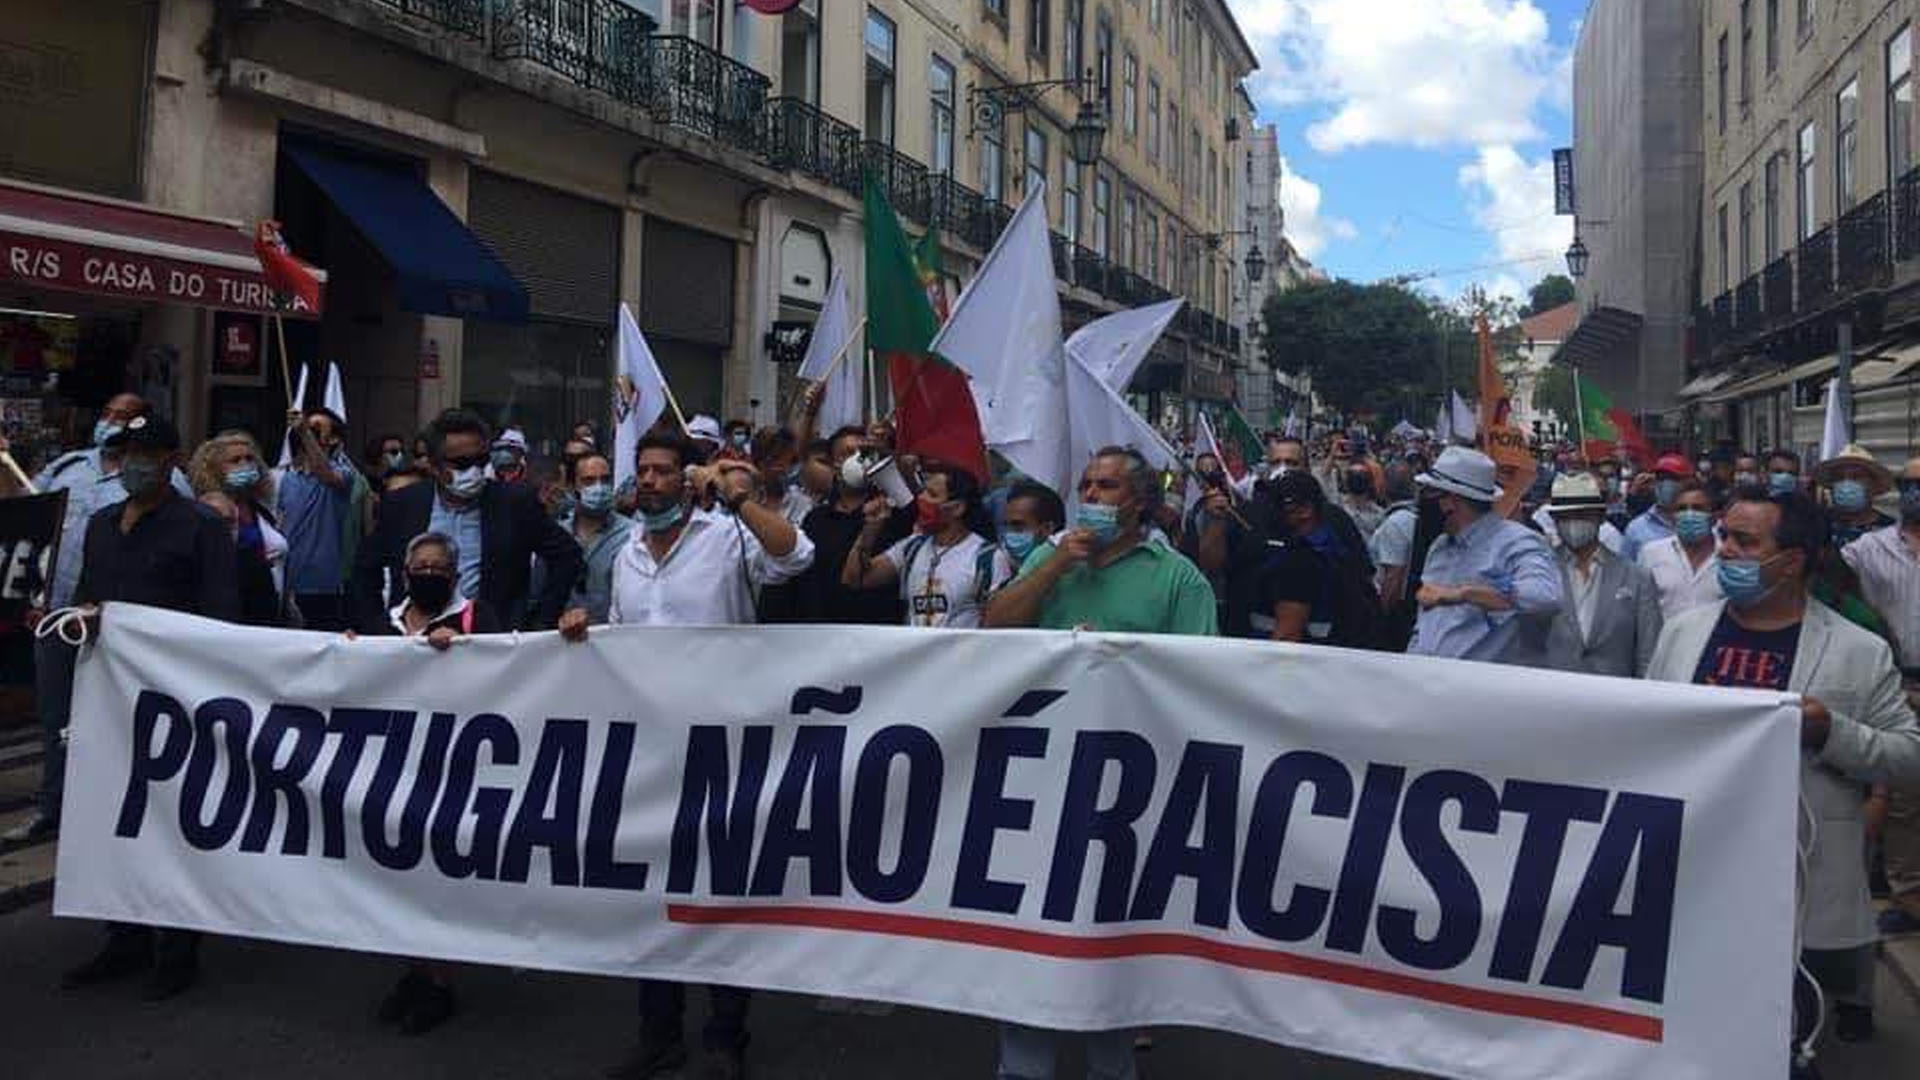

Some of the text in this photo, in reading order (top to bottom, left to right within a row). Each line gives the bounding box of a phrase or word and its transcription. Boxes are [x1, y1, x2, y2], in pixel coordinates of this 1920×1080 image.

[84, 258, 155, 292] CASA
[169, 271, 204, 297] DO
[217, 277, 309, 312] TURIA
[115, 685, 1685, 1004] PORTUGAL NÃO É RACISTA
